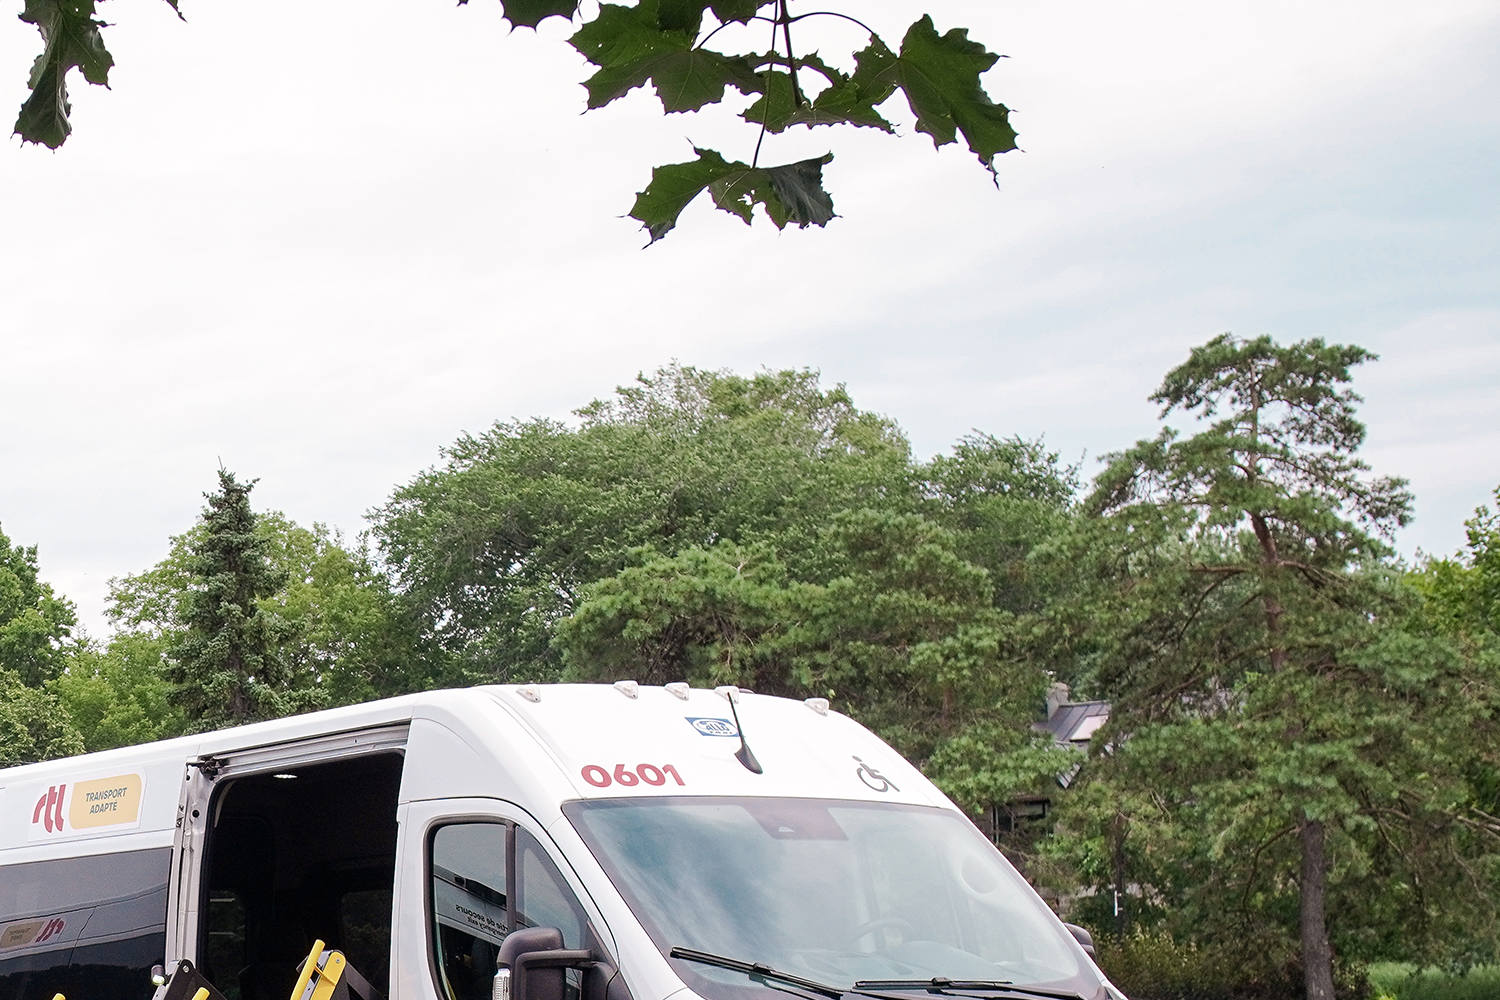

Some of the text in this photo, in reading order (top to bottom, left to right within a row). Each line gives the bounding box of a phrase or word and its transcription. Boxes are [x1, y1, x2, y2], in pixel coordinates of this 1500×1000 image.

[581, 763, 686, 787] 0601
[85, 787, 127, 802] TRANSPORT
[32, 784, 66, 833] rtl
[89, 799, 118, 814] ADAPTÉ
